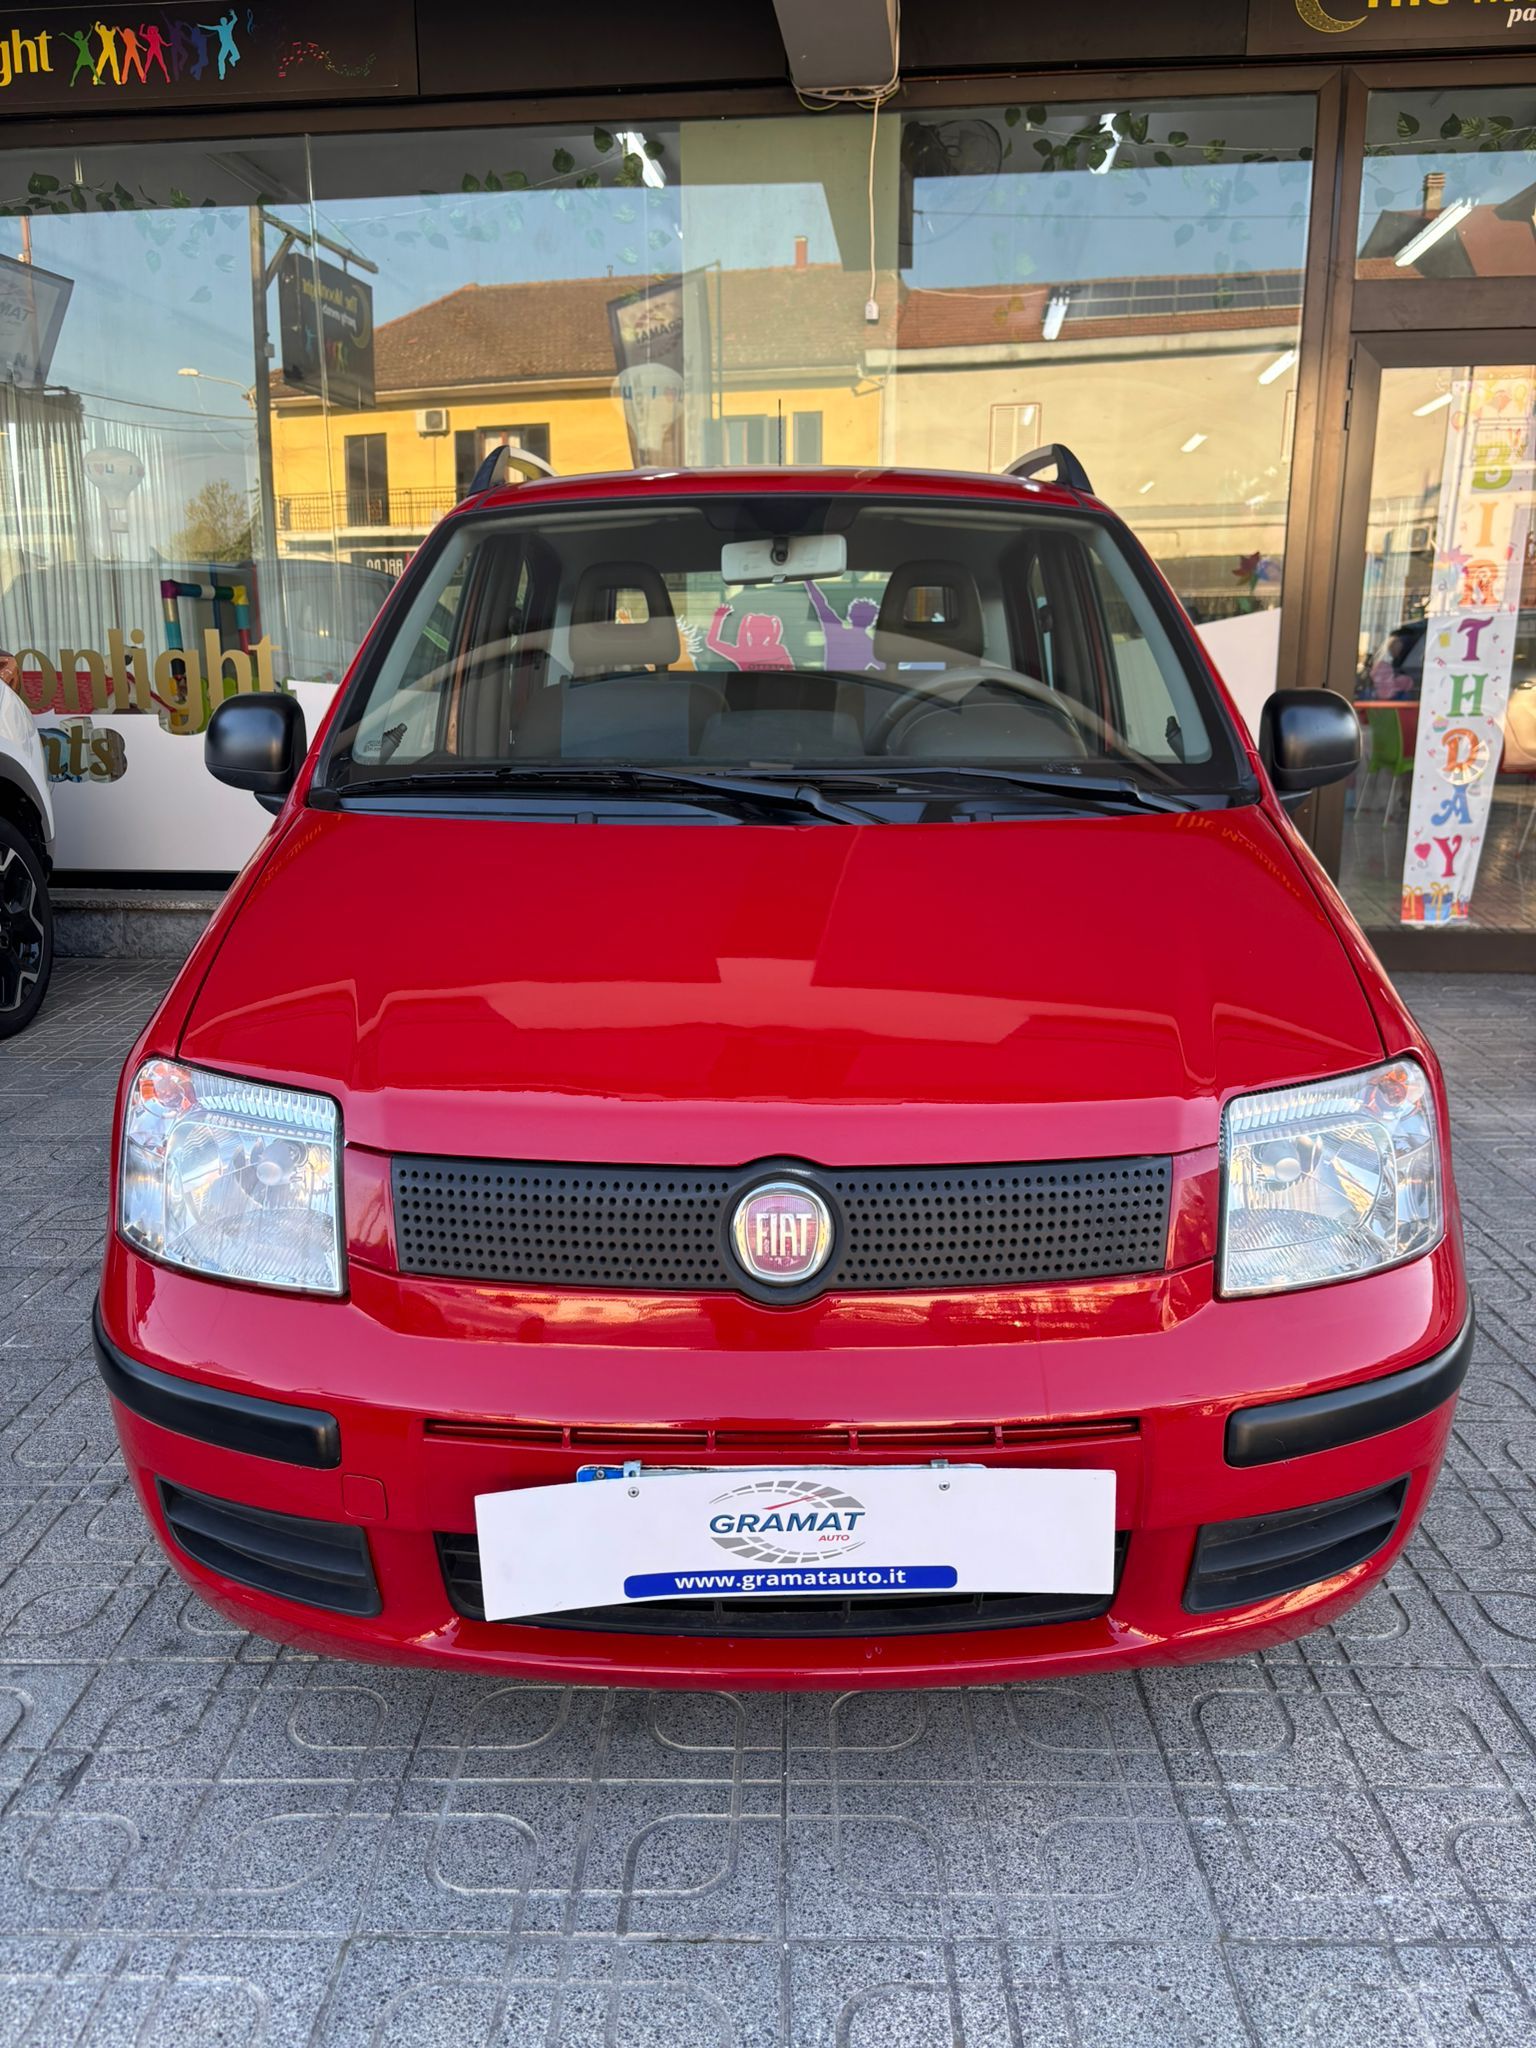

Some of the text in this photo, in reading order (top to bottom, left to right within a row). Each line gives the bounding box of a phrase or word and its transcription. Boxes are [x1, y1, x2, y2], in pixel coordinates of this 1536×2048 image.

[1430, 443, 1514, 879] BIRTHDAY
[756, 1213, 812, 1256] FIAT
[709, 1512, 865, 1534] GRAMAT
[818, 1534, 850, 1542] AUTO
[674, 1566, 906, 1591] www.gramatauto.it
